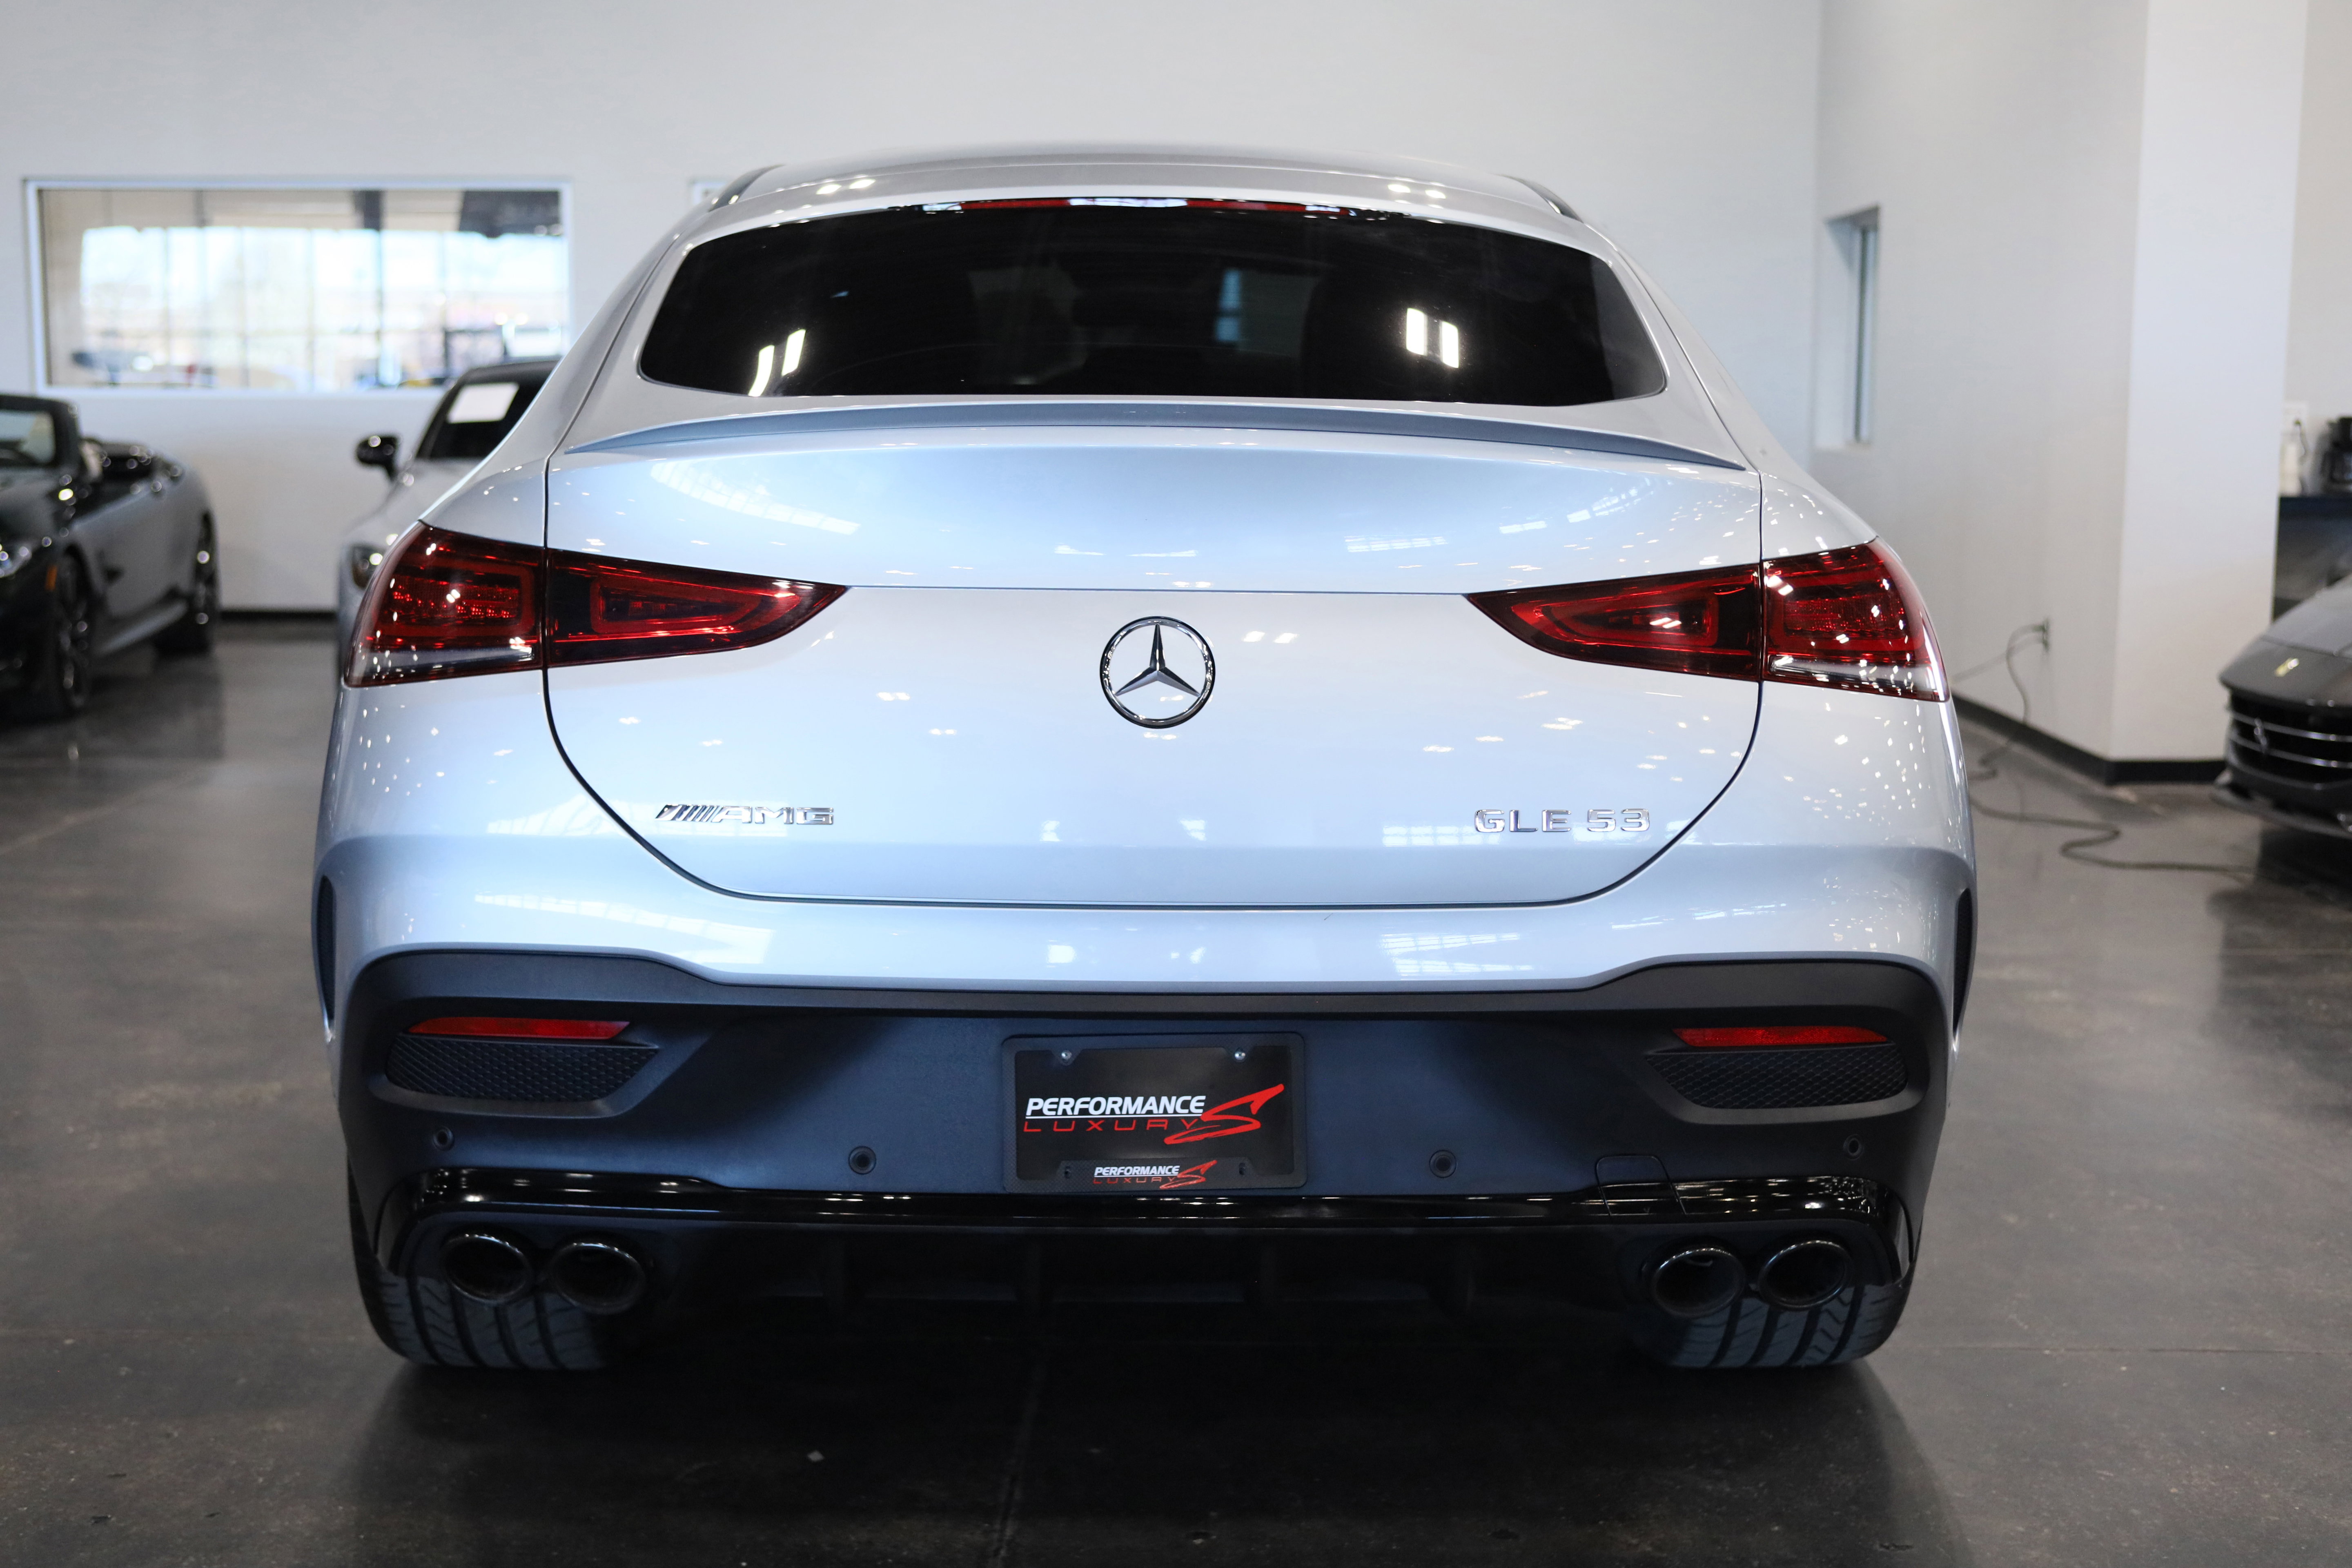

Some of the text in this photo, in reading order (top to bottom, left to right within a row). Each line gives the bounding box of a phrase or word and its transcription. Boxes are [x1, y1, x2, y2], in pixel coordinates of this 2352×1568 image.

[711, 806, 834, 824] AMG
[1474, 808, 1650, 832] GLE 53
[1026, 1096, 1206, 1116] PERFORMANCE
[1023, 1119, 1198, 1132] LUXURY
[1094, 1165, 1179, 1176] PERFORMANCE
